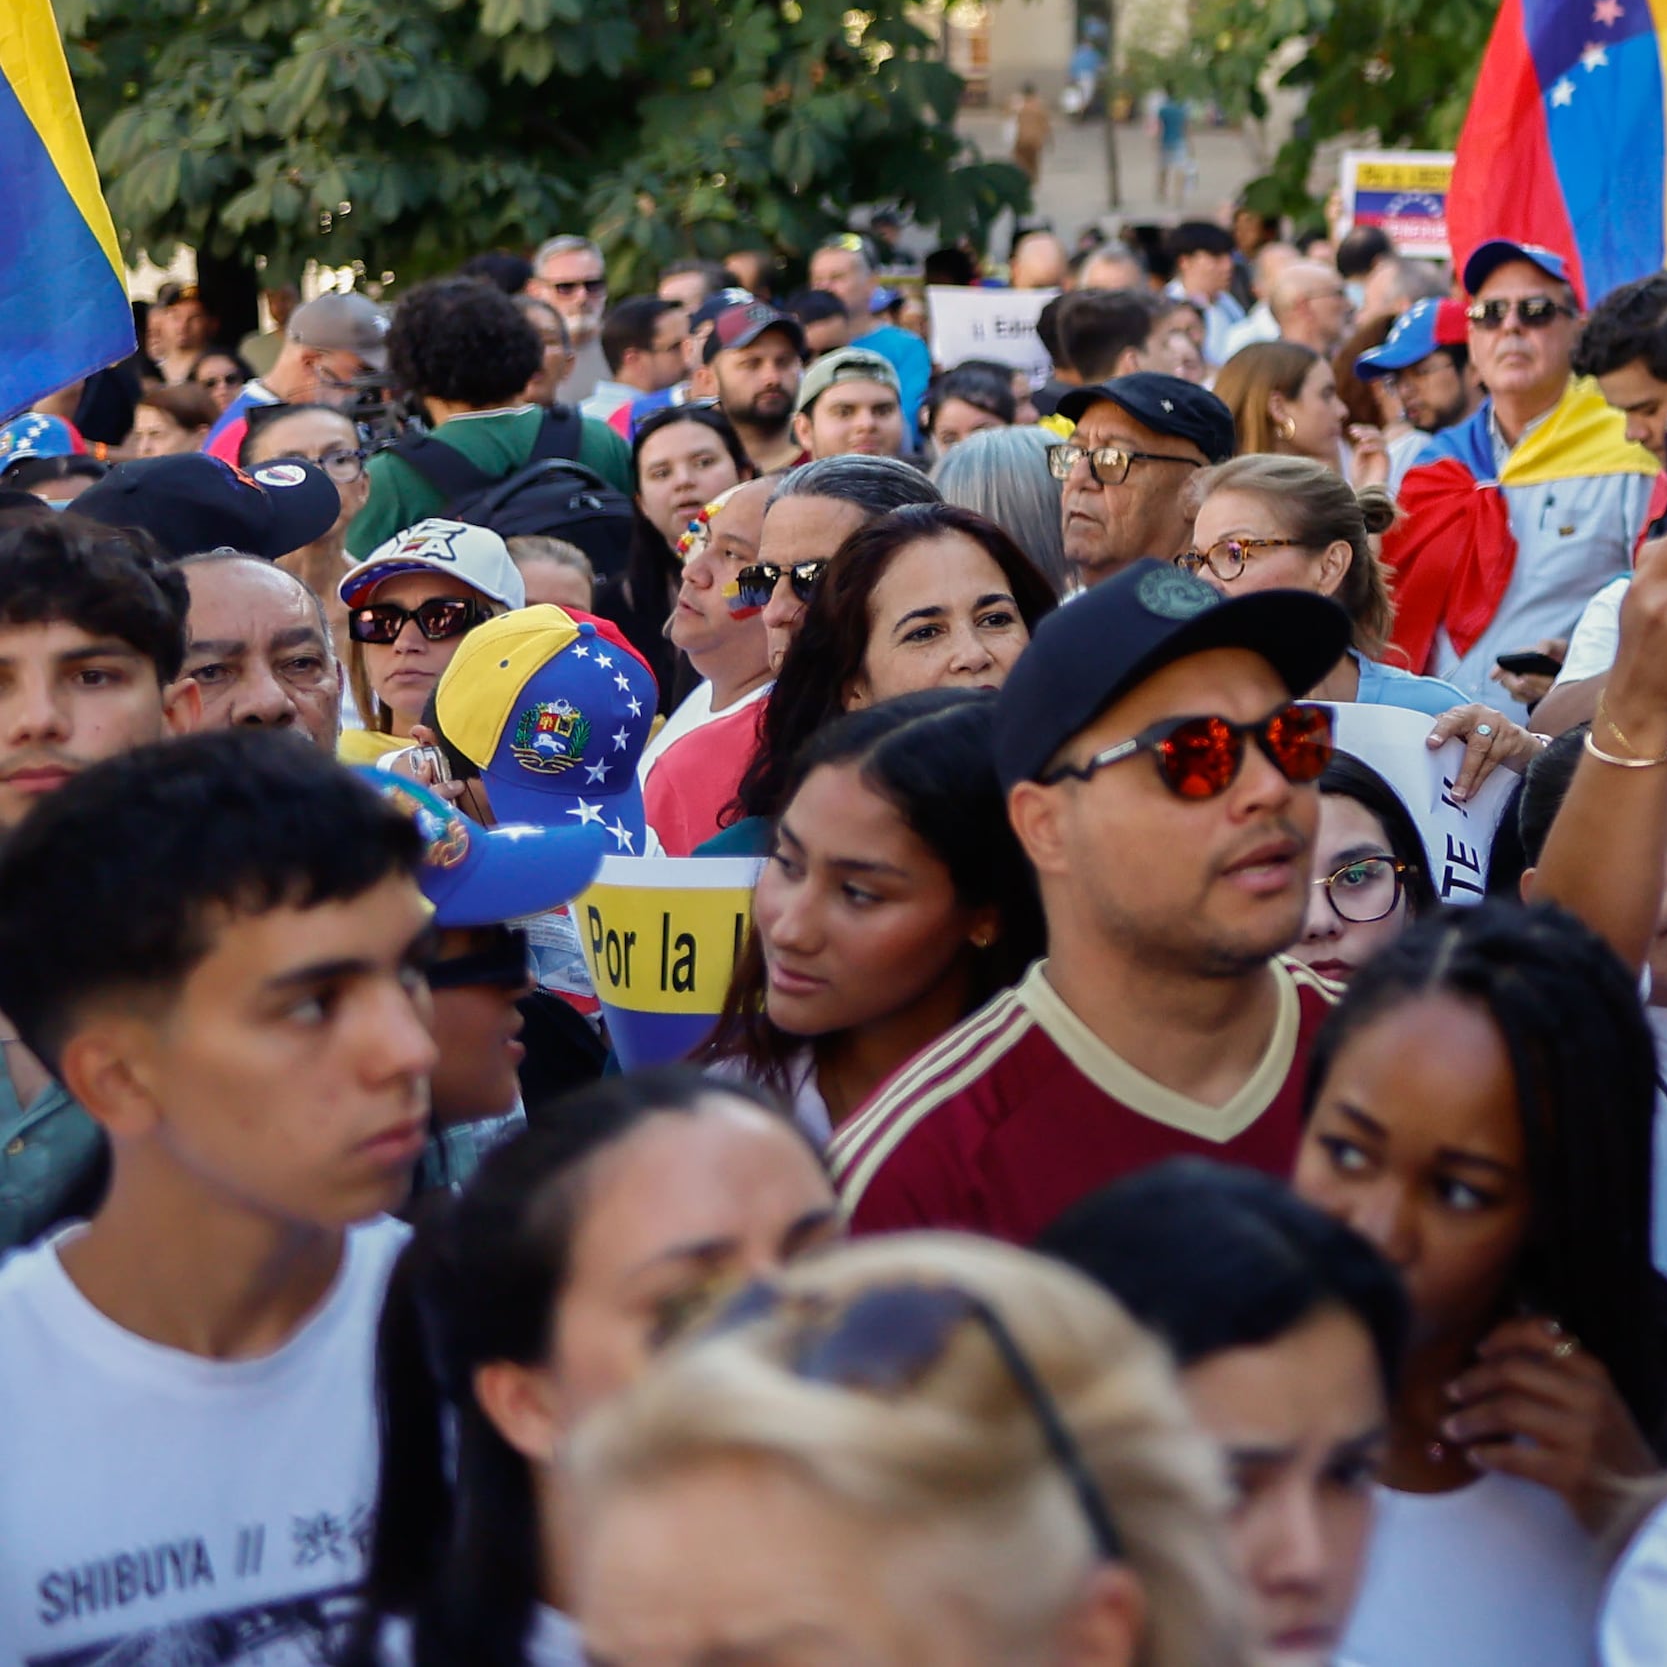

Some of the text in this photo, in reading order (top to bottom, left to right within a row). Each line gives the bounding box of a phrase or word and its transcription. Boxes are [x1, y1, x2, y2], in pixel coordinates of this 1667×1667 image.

[586, 903, 637, 990] Por
[660, 911, 697, 993] la
[38, 1535, 216, 1628] SHIBUYA
